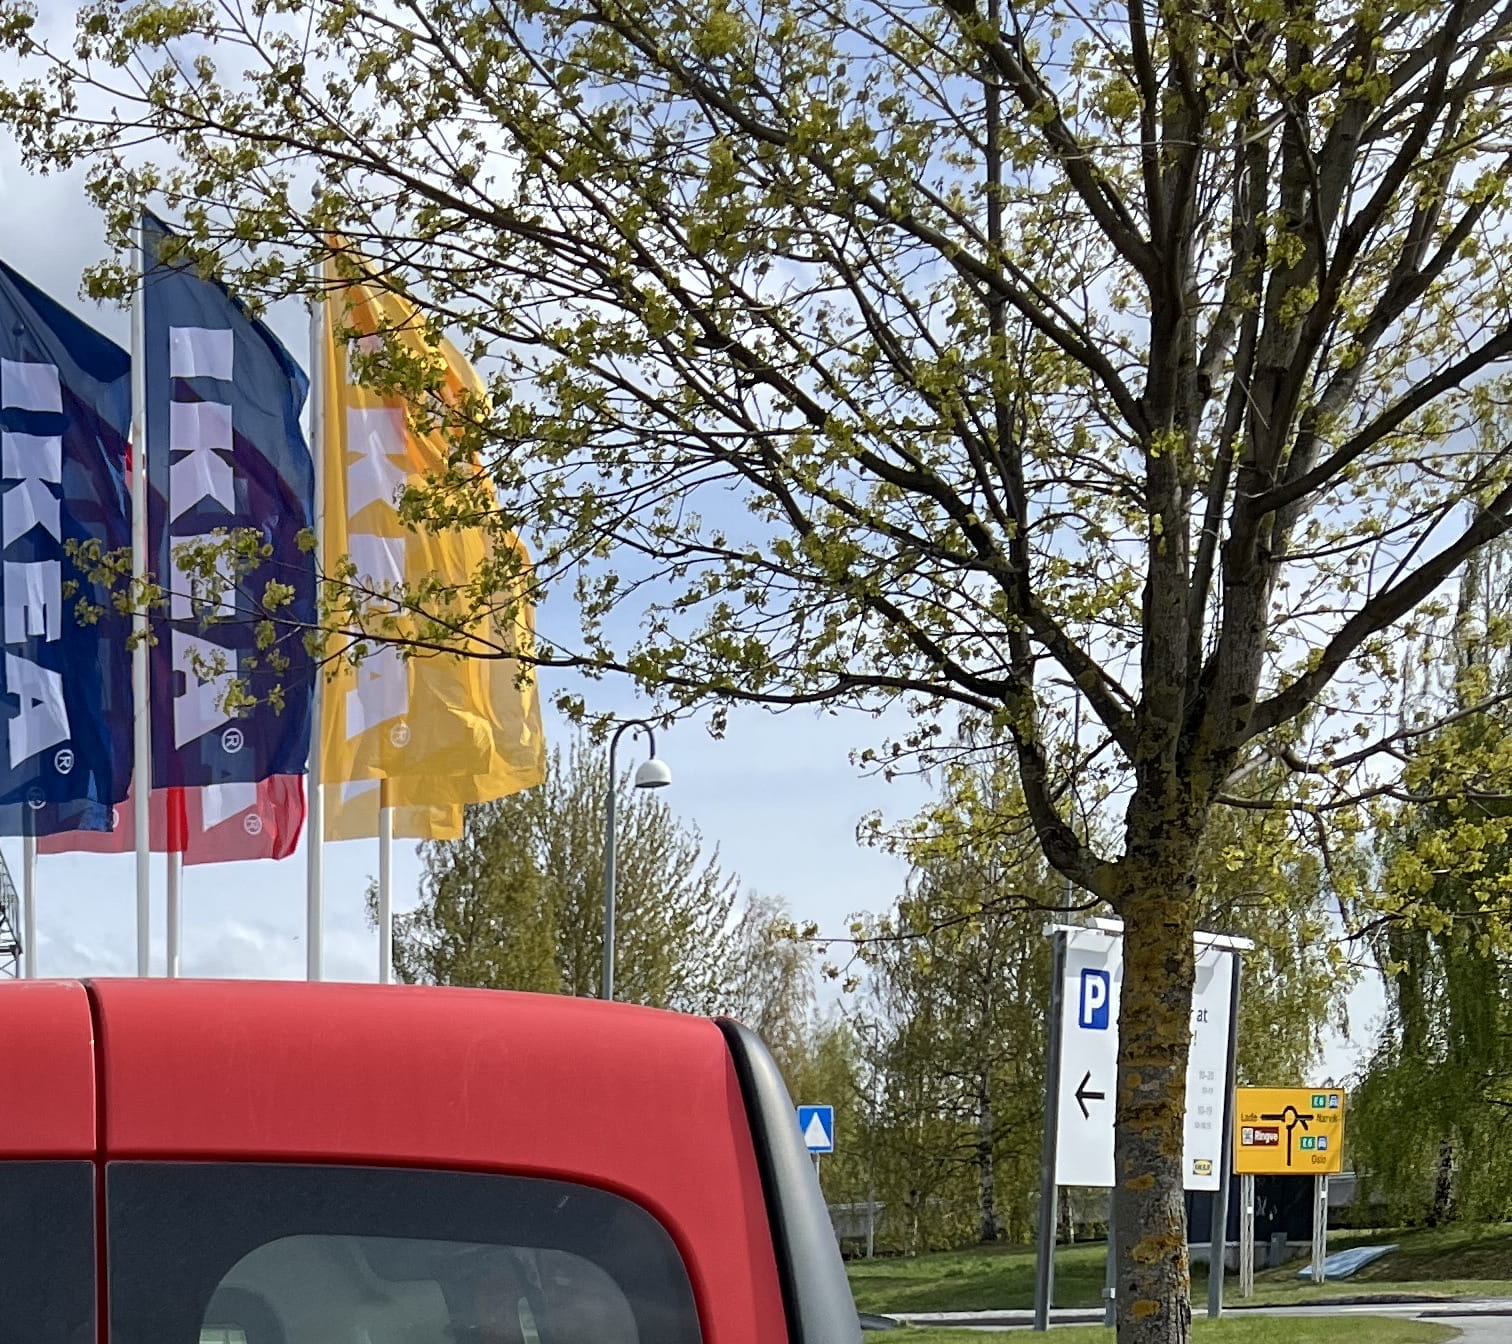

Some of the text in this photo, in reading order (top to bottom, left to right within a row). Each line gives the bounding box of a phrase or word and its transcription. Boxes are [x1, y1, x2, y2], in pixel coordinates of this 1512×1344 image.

[1, 360, 71, 770] IKEA
[169, 326, 238, 749] IKEA
[1084, 974, 1106, 1024] P
[1197, 1009, 1208, 1023] at
